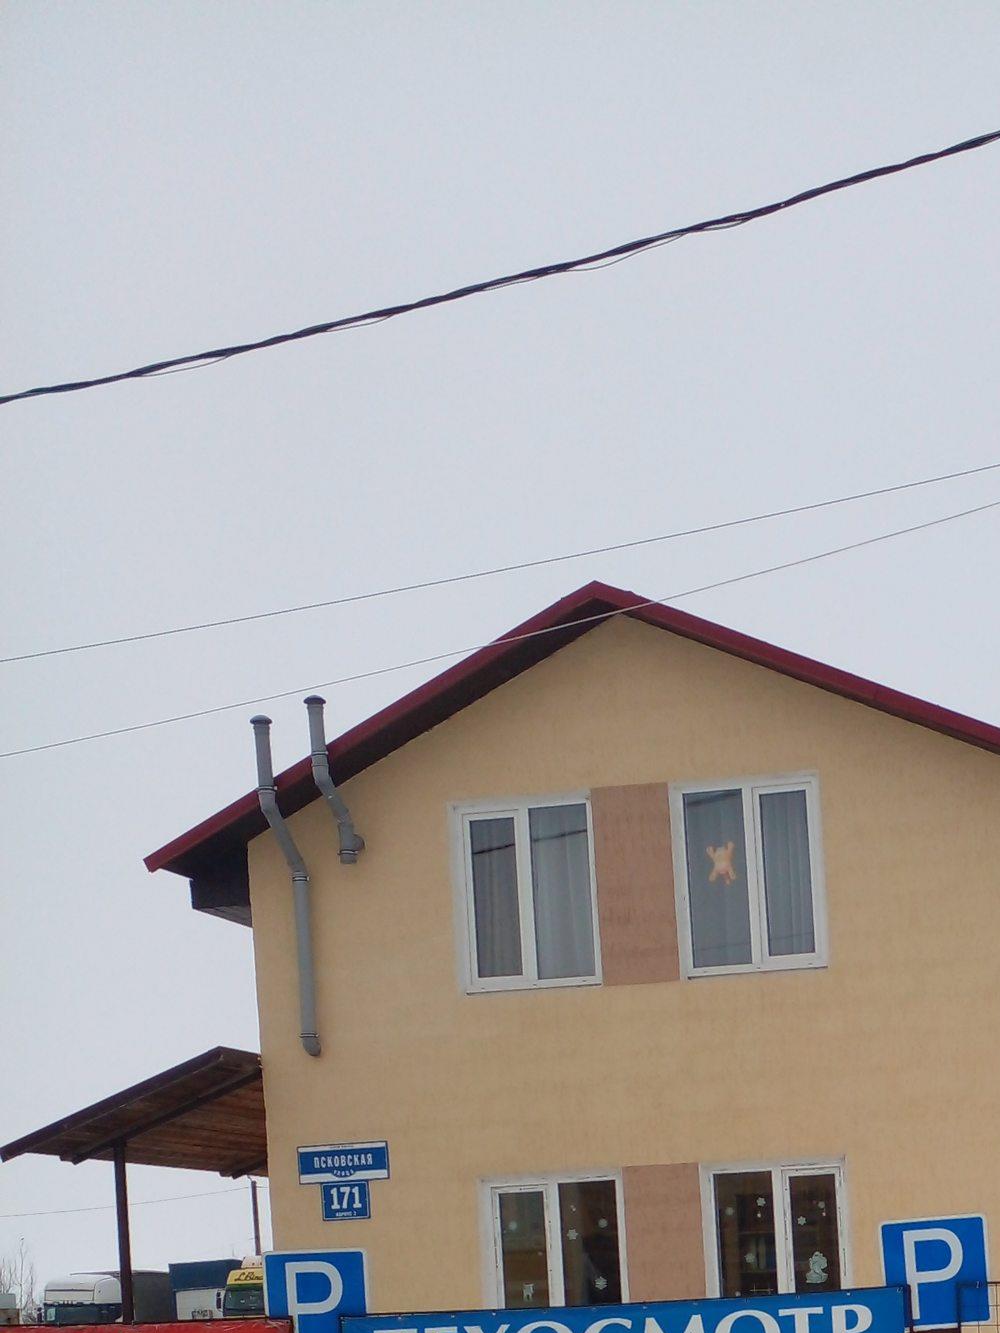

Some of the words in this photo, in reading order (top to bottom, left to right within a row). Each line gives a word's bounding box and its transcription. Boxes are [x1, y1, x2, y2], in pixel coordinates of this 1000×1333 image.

[314, 1153, 373, 1168] ПСКОВСКАЯ
[330, 1186, 362, 1210] 171
[903, 1228, 963, 1319] P
